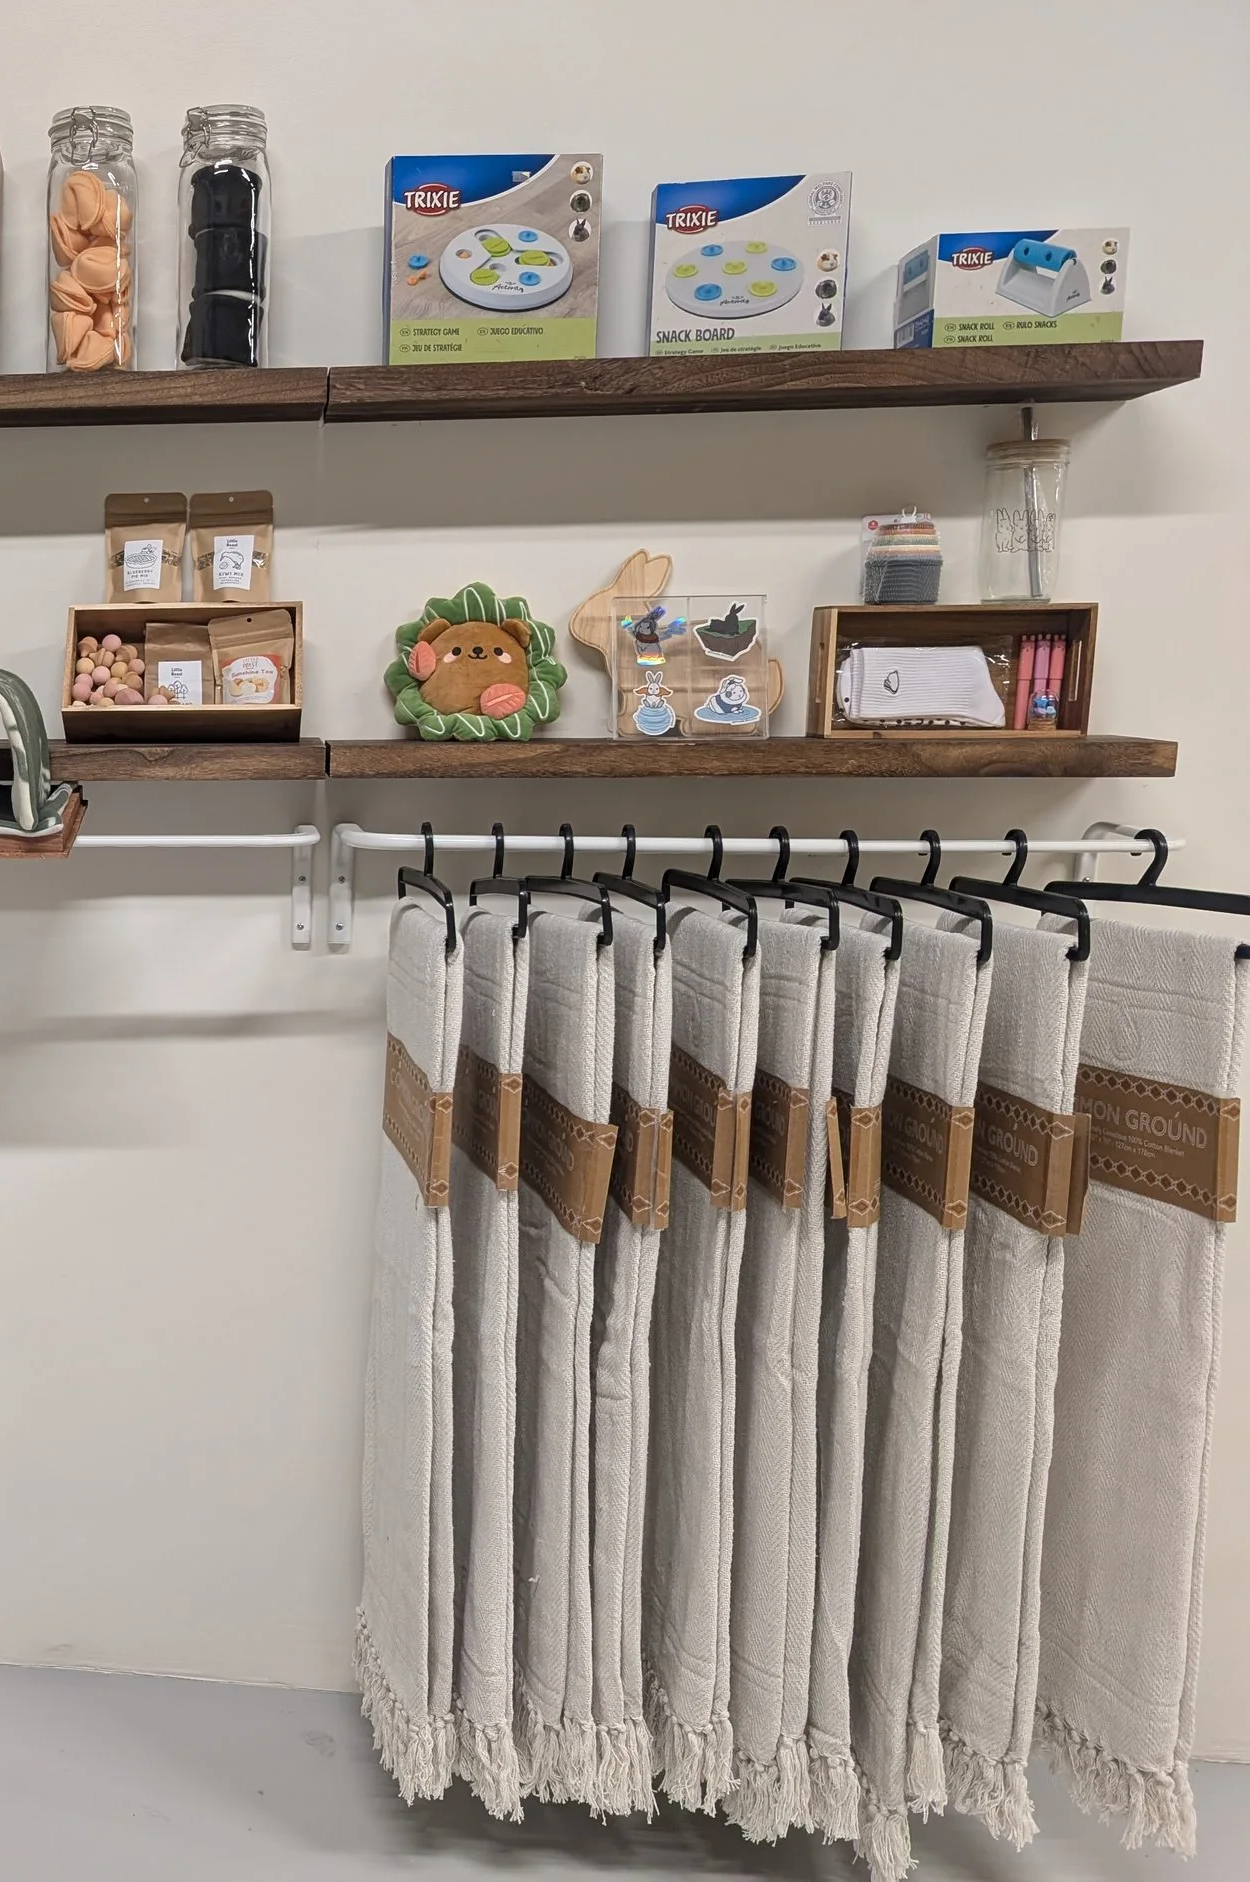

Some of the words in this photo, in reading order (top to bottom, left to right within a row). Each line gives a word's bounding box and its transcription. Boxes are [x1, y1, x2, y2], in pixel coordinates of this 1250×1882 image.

[404, 190, 460, 209] TRIXIE
[665, 210, 717, 229] TRIXIE
[951, 251, 993, 267] TRIXIE
[958, 323, 978, 331] SNACK
[979, 322, 995, 330] ROLL
[1016, 321, 1033, 329] RULO
[1034, 320, 1058, 329] SNACKS
[413, 328, 442, 337] STRATEGY
[442, 327, 460, 336] GAME
[489, 327, 510, 336] JUEGO
[511, 326, 544, 336] EDUCATIVO
[655, 329, 692, 344] SNACK
[695, 327, 736, 342] BOARD
[957, 335, 977, 343] SNACK
[978, 335, 993, 343] ROLL
[411, 344, 423, 352] JEU
[423, 344, 432, 352] DE
[433, 342, 463, 352] STRATÉGIE
[1128, 1135, 1144, 1147] 100%
[1143, 1138, 1164, 1151] Cotton
[1164, 1144, 1186, 1157] Blanket
